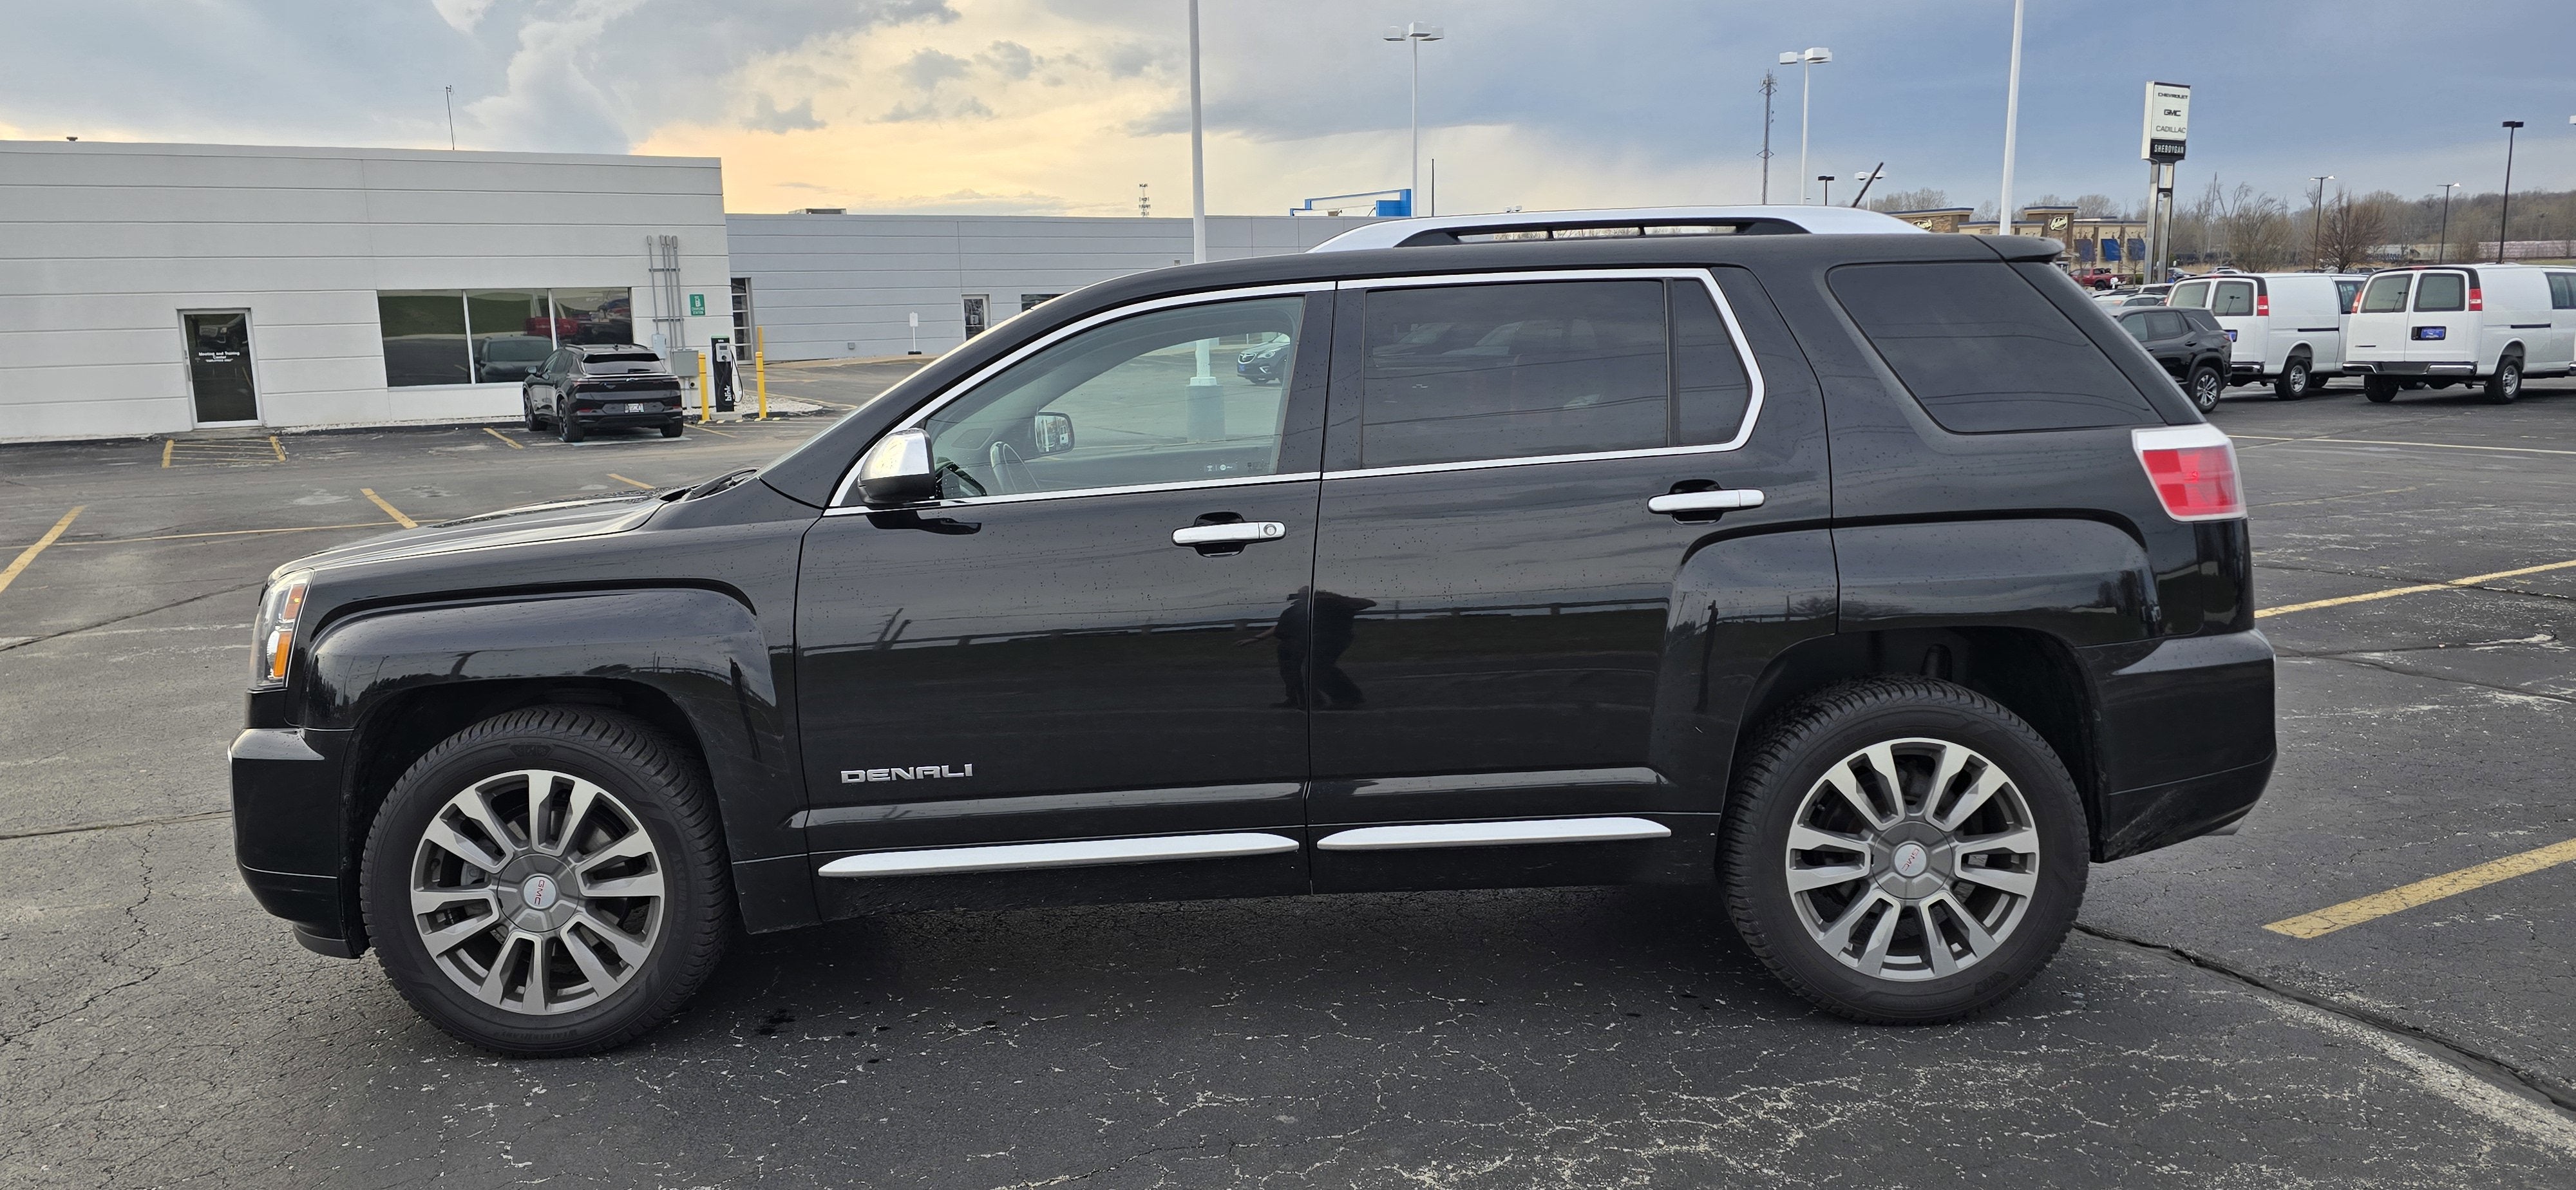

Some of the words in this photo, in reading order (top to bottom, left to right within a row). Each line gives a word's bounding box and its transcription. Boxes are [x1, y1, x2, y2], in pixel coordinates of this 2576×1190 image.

[2155, 125, 2187, 133] CADILLAC
[2154, 144, 2184, 154] SHEBOYGAN
[724, 385, 732, 402] blink
[840, 763, 973, 784] DENALI
[1901, 847, 1920, 872] GMC
[534, 879, 545, 905] GMC
